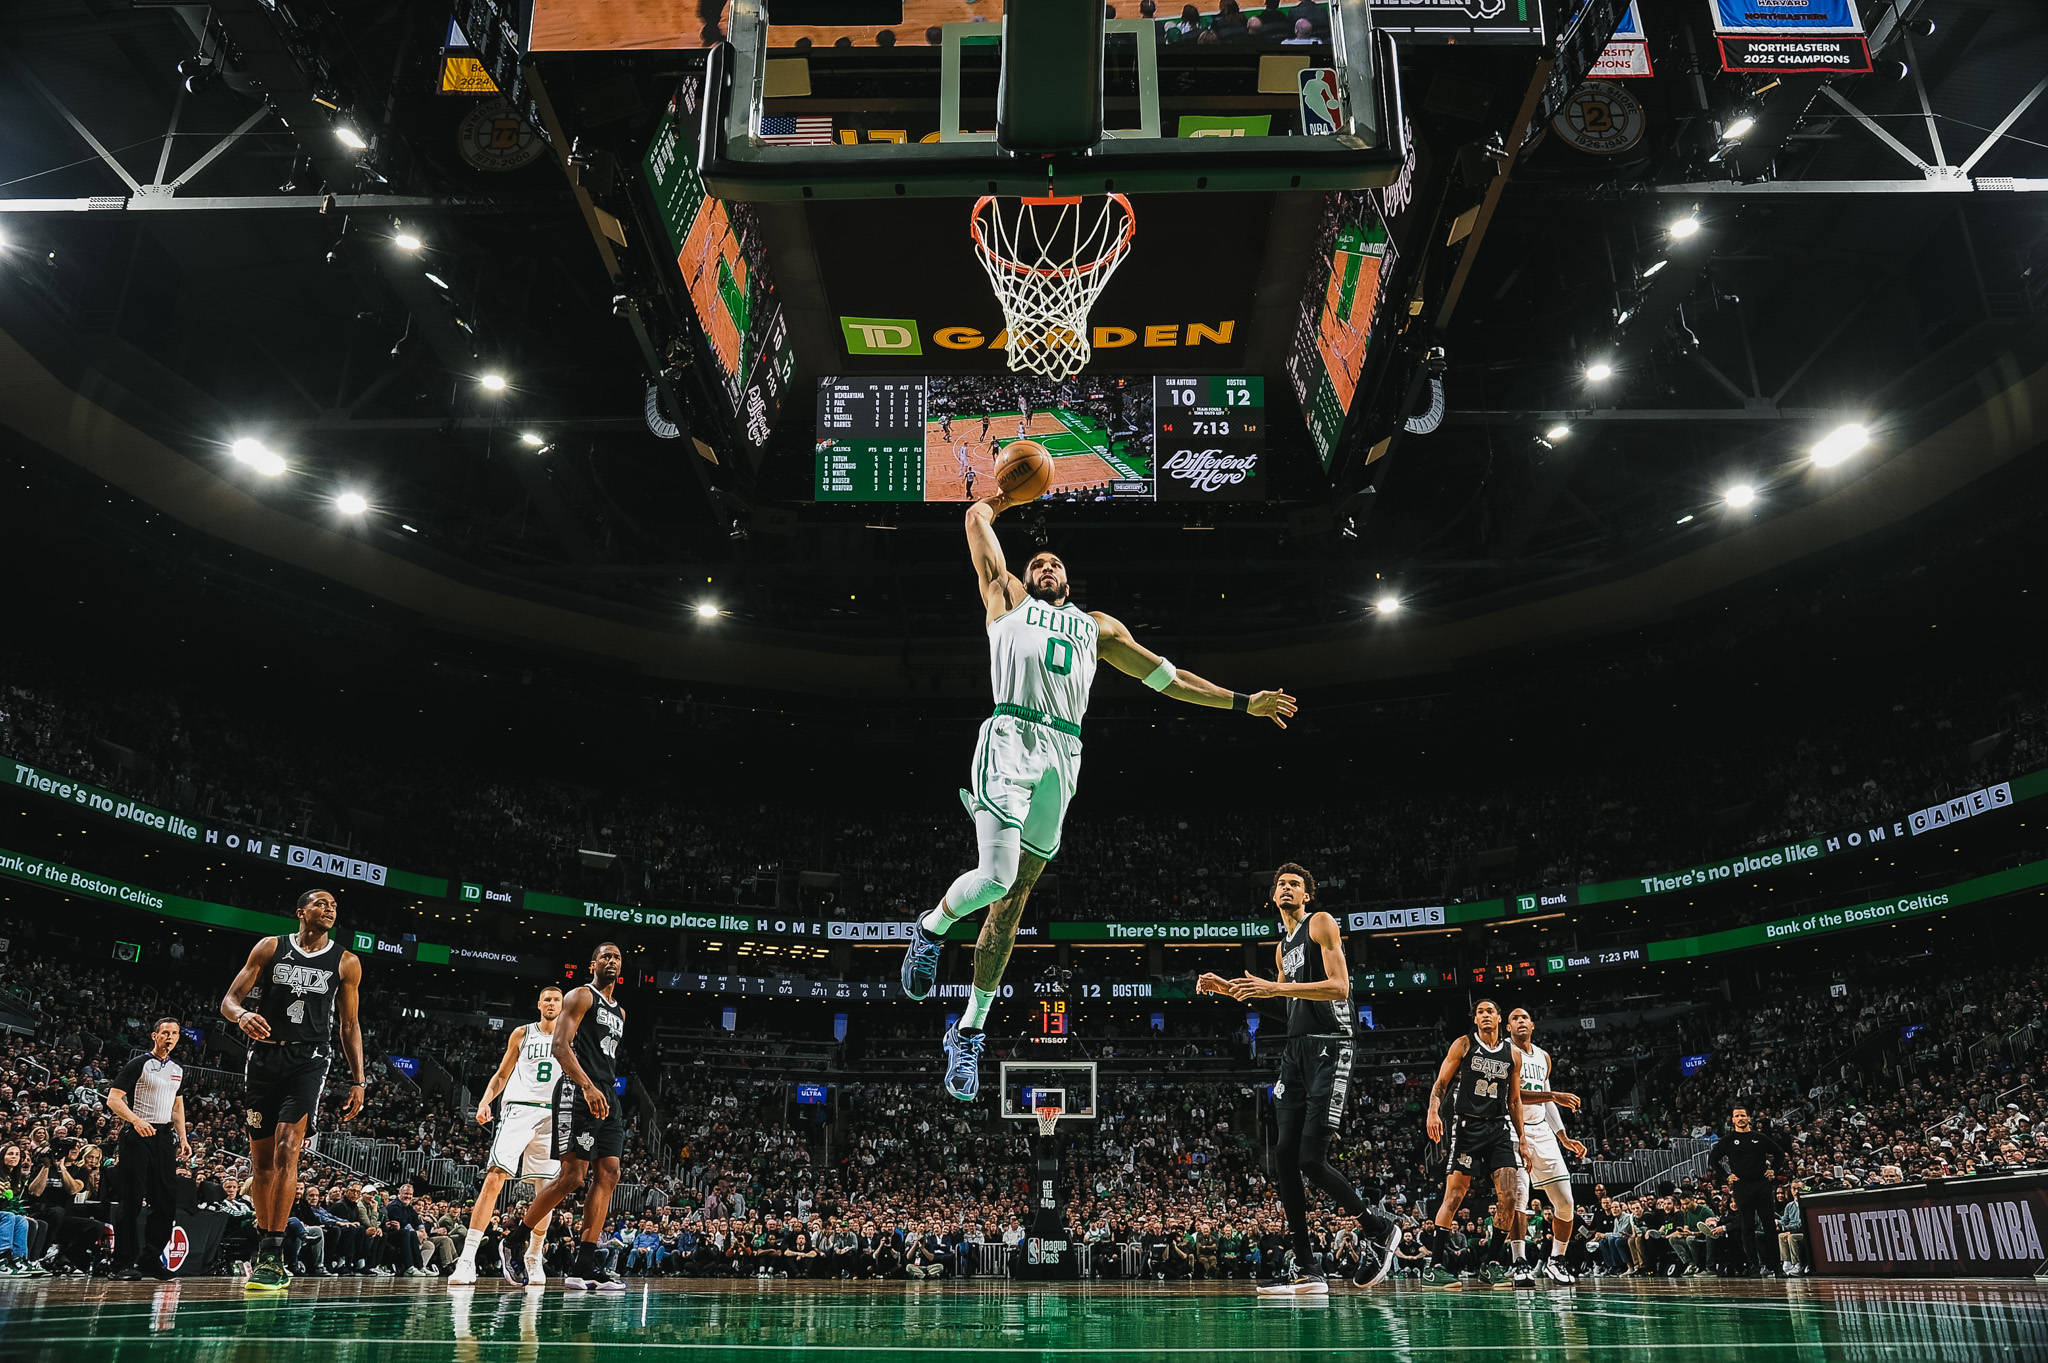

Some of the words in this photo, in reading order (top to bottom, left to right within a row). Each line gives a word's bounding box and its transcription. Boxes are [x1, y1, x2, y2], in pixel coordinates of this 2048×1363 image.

[1744, 12, 1828, 20] NORTHEASTERN
[1600, 48, 1634, 56] RSITY
[1744, 55, 1774, 63] 2025
[1778, 55, 1850, 63] CHAMPIONS
[1594, 60, 1631, 68] PIONS
[460, 78, 491, 86] 2024
[1588, 107, 1605, 126] 2
[848, 323, 912, 349] TD
[932, 320, 1236, 351] GARDEN
[1172, 390, 1195, 405] 10
[1227, 390, 1250, 405] 12
[1162, 424, 1173, 432] 14
[1193, 422, 1229, 435] 7:13
[1244, 424, 1256, 432] 1st
[1162, 450, 1258, 479] Different
[1190, 469, 1247, 492] Here
[1026, 606, 1094, 650] CELTICS
[1044, 636, 1074, 676] 0
[16, 763, 86, 803] There's
[90, 794, 113, 811] no
[115, 803, 165, 828] place
[168, 816, 196, 839] like
[205, 828, 281, 860] HOME
[291, 848, 383, 882] GAMES
[1641, 870, 1705, 892] There's
[1709, 866, 1730, 880] no
[1733, 854, 1782, 877] place
[1785, 845, 1818, 862] like
[1826, 822, 1904, 852] HOME
[1912, 786, 2008, 830] GAMES
[27, 864, 44, 876] of
[46, 867, 67, 882] the
[71, 873, 117, 896] Boston
[120, 887, 163, 908] Celtics
[463, 885, 480, 900] TD
[486, 891, 511, 902] Bank
[1518, 898, 1535, 910] TD
[1541, 894, 1566, 905] Bank
[584, 903, 642, 923] There's
[646, 914, 667, 925] no
[670, 913, 716, 928] place
[720, 916, 748, 930] like
[757, 919, 822, 935] HOME
[831, 924, 915, 937] GAMES
[1107, 924, 1166, 937] There's
[1170, 927, 1190, 936] no
[1194, 924, 1238, 939] place
[1242, 923, 1269, 936] like
[1352, 908, 1441, 928] GAMES
[1767, 921, 1800, 937] Bank
[1803, 917, 1815, 929] of
[1819, 915, 1842, 927] the
[1845, 905, 1895, 922] Boston
[1898, 895, 1948, 911] Celtics
[356, 935, 372, 950] TD
[378, 941, 402, 953] Bank
[461, 948, 500, 960] De'AARON
[1550, 958, 1564, 970] TD
[1568, 956, 1590, 966] Bank
[1599, 953, 1620, 963] 7:23
[1623, 950, 1639, 960] PM
[272, 963, 334, 994] SATX
[1476, 974, 1483, 982] 12
[778, 986, 793, 994] 0/3
[811, 988, 828, 996] 5/11
[940, 984, 971, 998] ANTON
[1082, 985, 1100, 997] 12
[1113, 984, 1151, 996] BOSTON
[286, 1000, 305, 1024] 4
[1040, 1000, 1065, 1013] 7:13
[1044, 1013, 1063, 1034] 13
[528, 1042, 550, 1060] CELT
[600, 1035, 618, 1059] 40
[536, 1061, 552, 1082] 8
[1470, 1056, 1510, 1079] SATX
[1474, 1079, 1498, 1099] 24
[1042, 1180, 1053, 1190] GET
[1042, 1190, 1053, 1198] THE
[1818, 1214, 1849, 1262] THE
[1850, 1208, 1917, 1262] BETTER
[1912, 1206, 1958, 1261] WAY
[1956, 1203, 1991, 1262] TO
[1987, 1200, 2046, 1260] NBA
[1041, 1238, 1067, 1253] League
[1041, 1251, 1059, 1264] Pass
